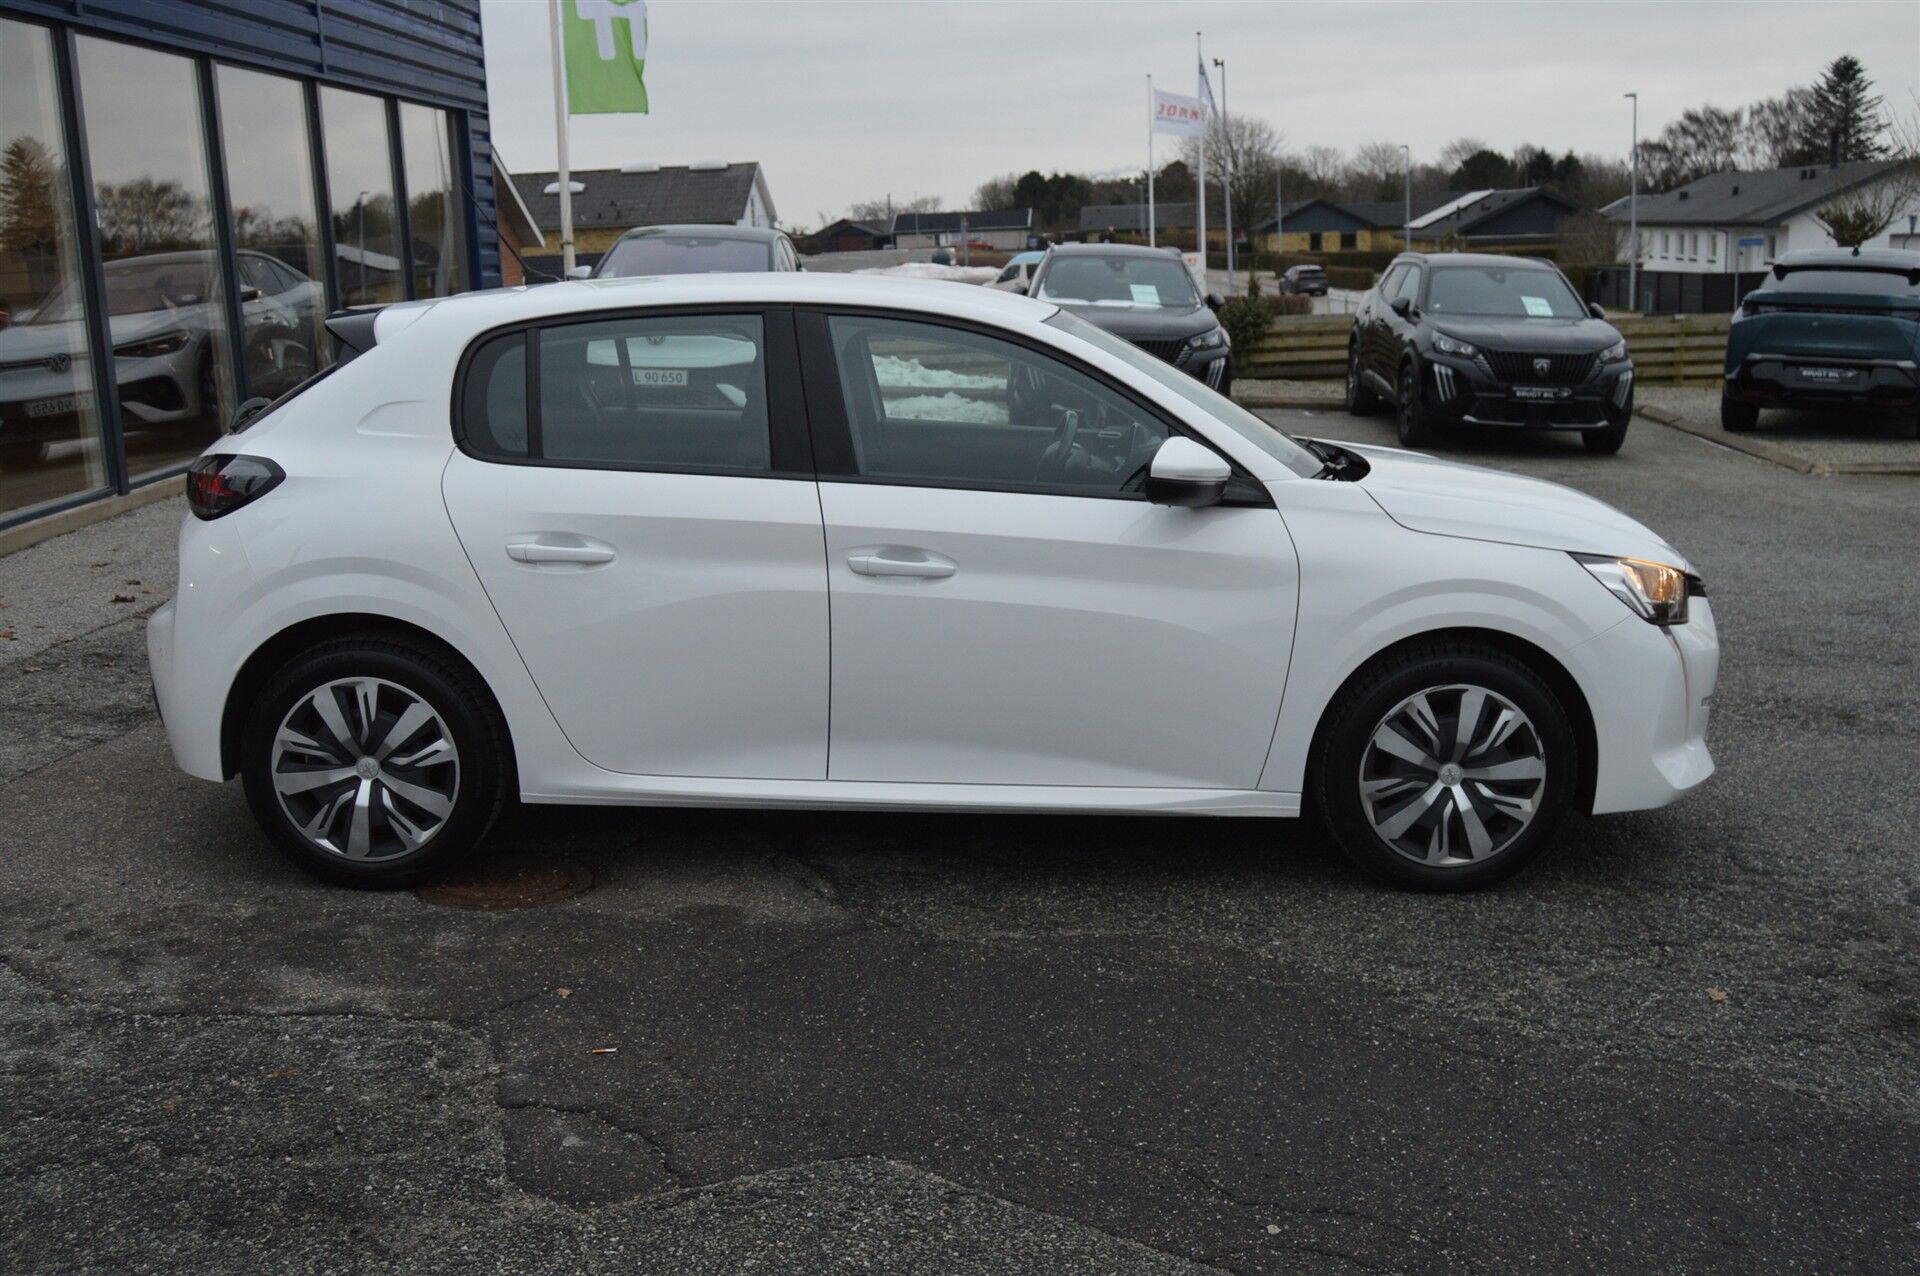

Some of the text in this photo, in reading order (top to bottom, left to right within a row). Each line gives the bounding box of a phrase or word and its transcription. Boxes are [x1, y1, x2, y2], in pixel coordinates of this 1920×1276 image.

[634, 372, 683, 383] L 90 650
